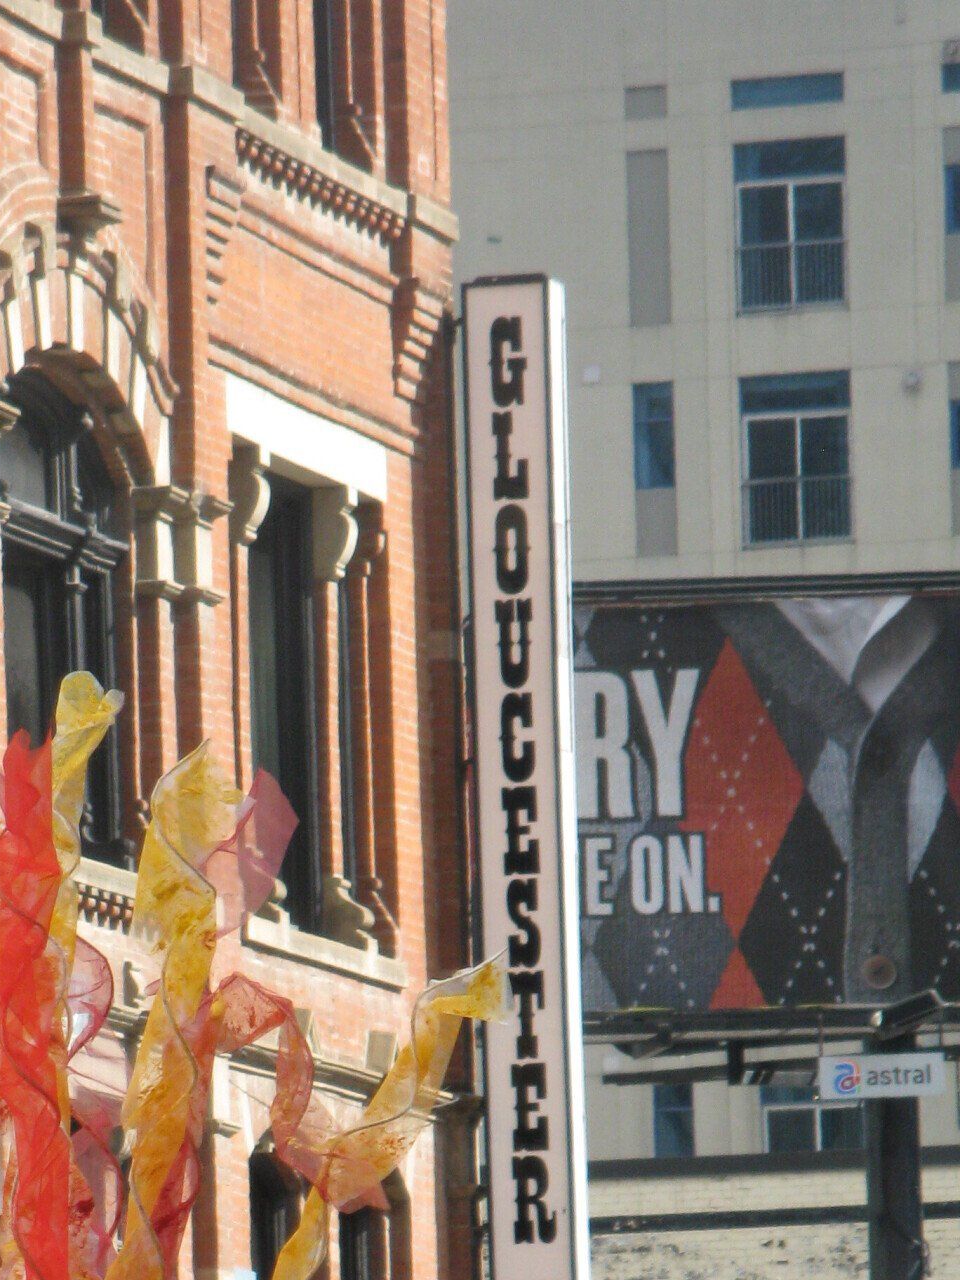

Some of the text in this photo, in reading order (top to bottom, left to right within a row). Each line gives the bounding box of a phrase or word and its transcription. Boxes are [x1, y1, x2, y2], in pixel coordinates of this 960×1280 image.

[488, 315, 557, 1245] GLOUCESTER
[631, 833, 720, 914] ON.
[866, 1065, 931, 1087] astral
